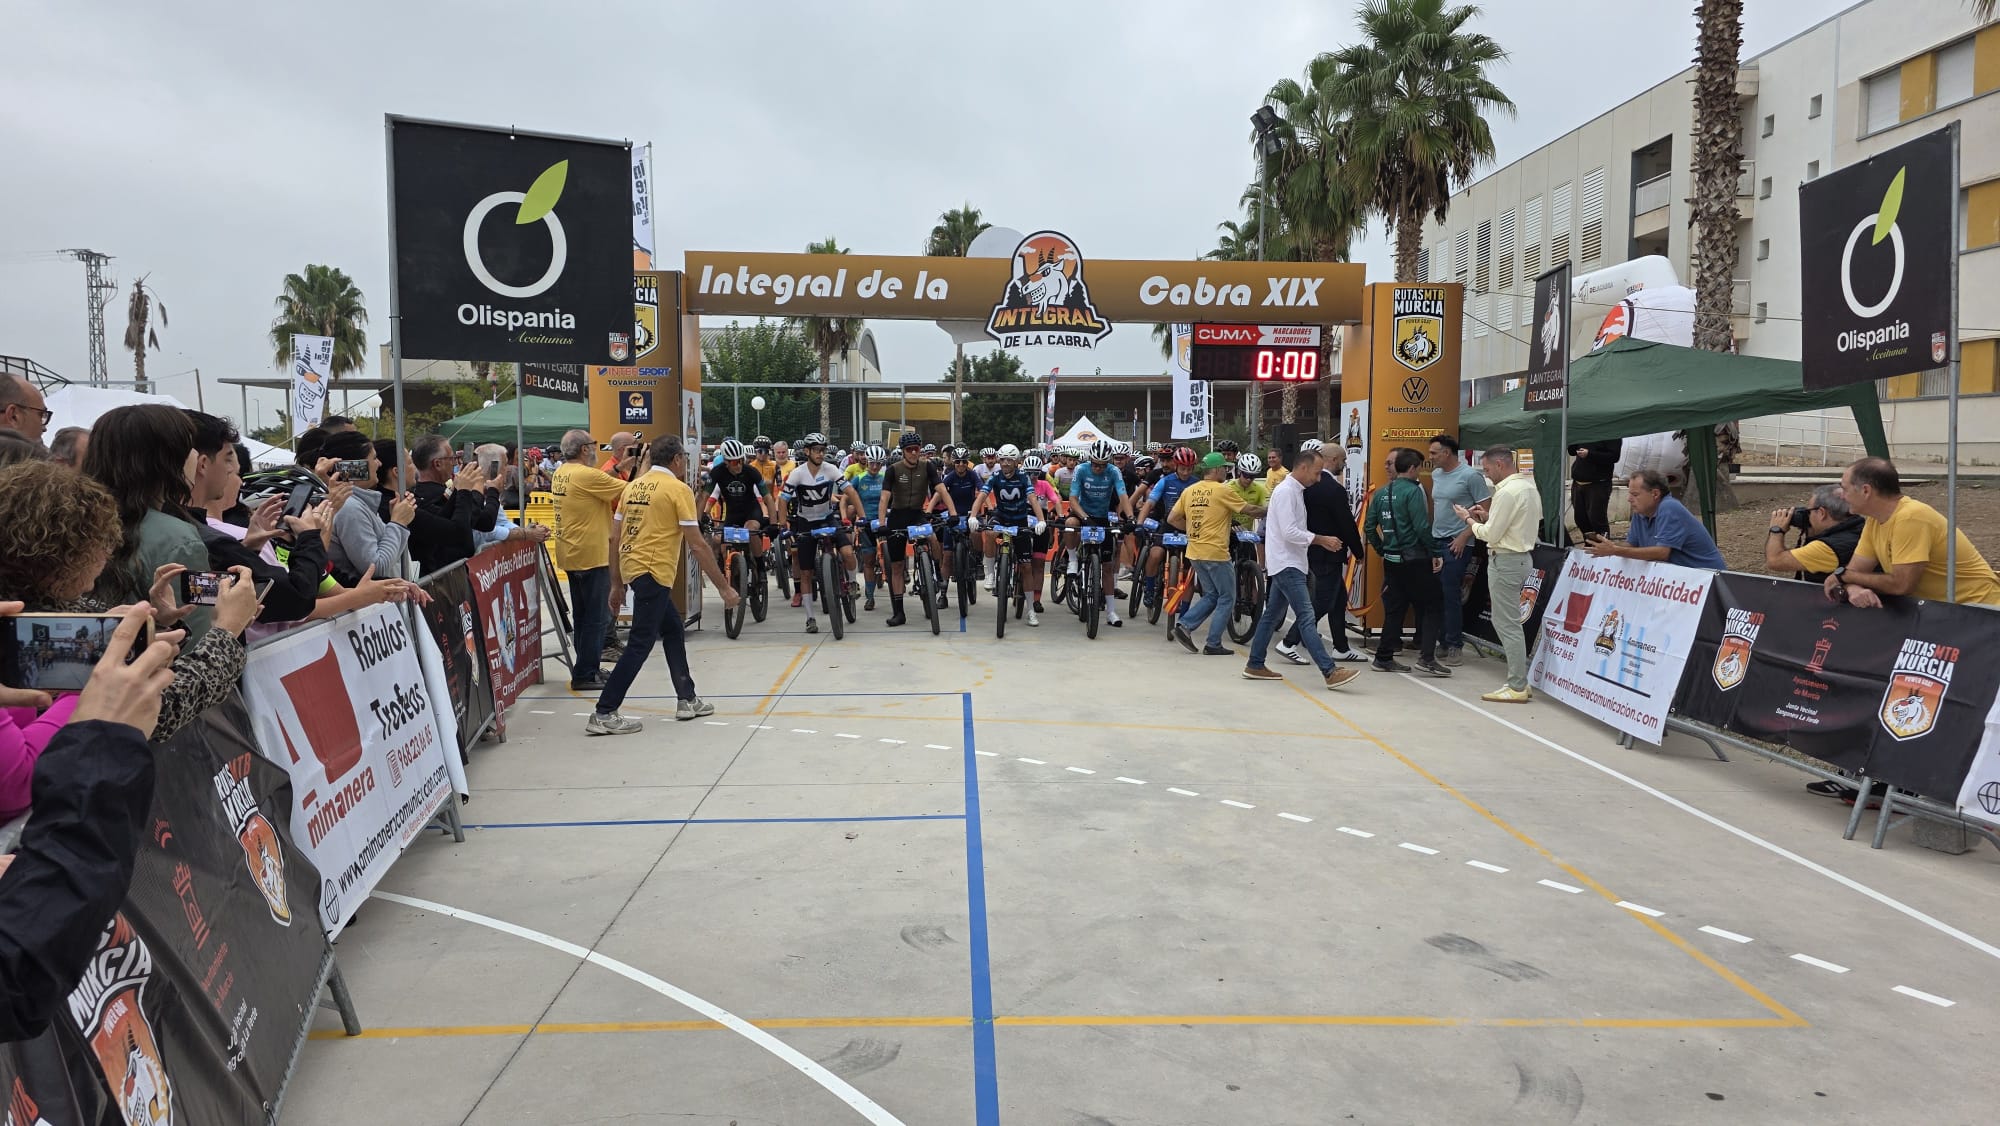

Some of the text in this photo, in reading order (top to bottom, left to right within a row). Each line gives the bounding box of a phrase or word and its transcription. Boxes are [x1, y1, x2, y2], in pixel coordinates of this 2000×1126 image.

[699, 265, 949, 305] Integral de la
[1139, 275, 1326, 307] Cabra XIX
[457, 303, 576, 331] Olispania
[993, 306, 1103, 329] INTEGRAL
[1394, 300, 1444, 315] MURCIA
[508, 330, 575, 345] Aceitunas
[1004, 334, 1092, 349] DE LA CABRA
[1198, 328, 1252, 341] CUMA
[1272, 327, 1313, 336] MARCADORES
[1273, 336, 1312, 344] DEPORTIVOS
[1837, 319, 1910, 352] Olispania
[608, 367, 671, 377] INTERSPORT
[1256, 351, 1317, 379] 0:00
[525, 373, 579, 394] DELACABRA
[1527, 387, 1564, 402] DELACABRA
[625, 407, 648, 417] DFM
[1635, 575, 1704, 606] Publicidad
[1724, 618, 1761, 641] MURCIA
[347, 614, 407, 672] Rótulos
[1893, 651, 1955, 682] MURCIA
[369, 682, 426, 741] Trofeos
[306, 765, 375, 849] mimanera
